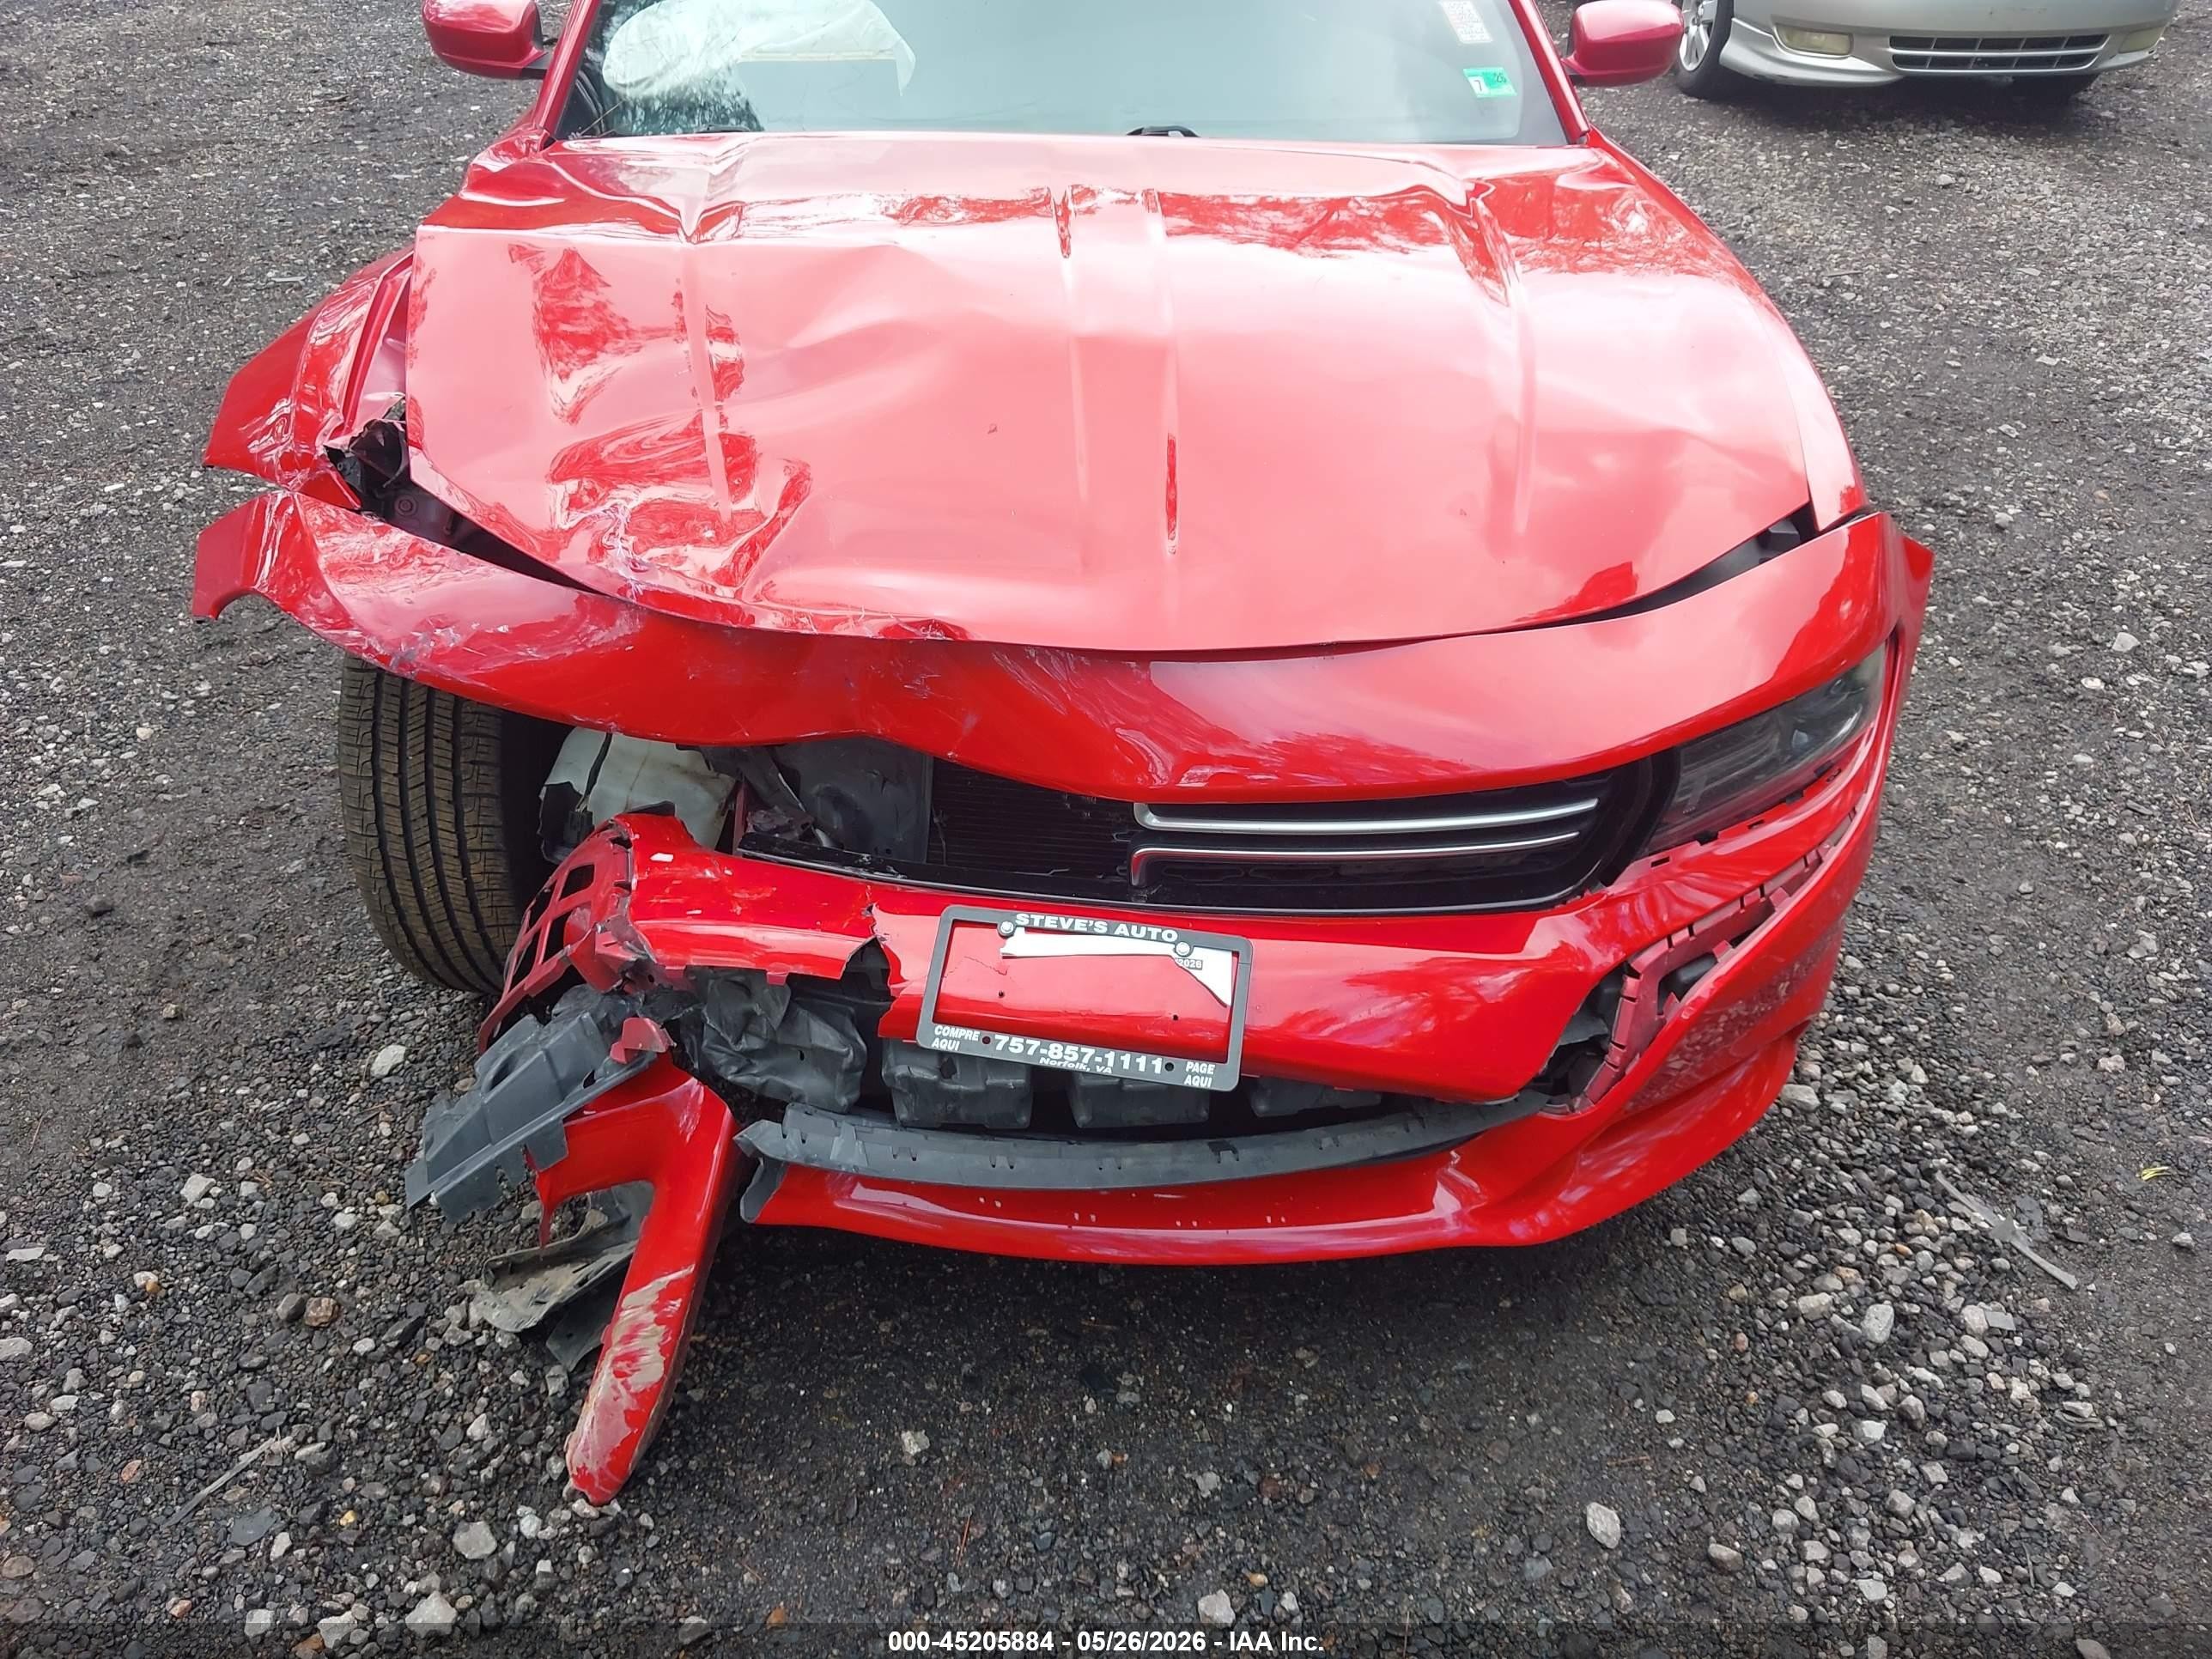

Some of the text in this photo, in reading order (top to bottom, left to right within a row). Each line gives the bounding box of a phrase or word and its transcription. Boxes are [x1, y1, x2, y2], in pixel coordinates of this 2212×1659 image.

[1016, 913, 1178, 942] STEVE'S AUTO
[934, 1025, 981, 1042] COMPRE
[932, 1037, 960, 1051] AQUI
[994, 1034, 1163, 1073] 757-857-1111
[1039, 1057, 1112, 1074] Norfolk, VA
[1185, 1061, 1215, 1075] PAGE
[1184, 1075, 1212, 1088] AQUI
